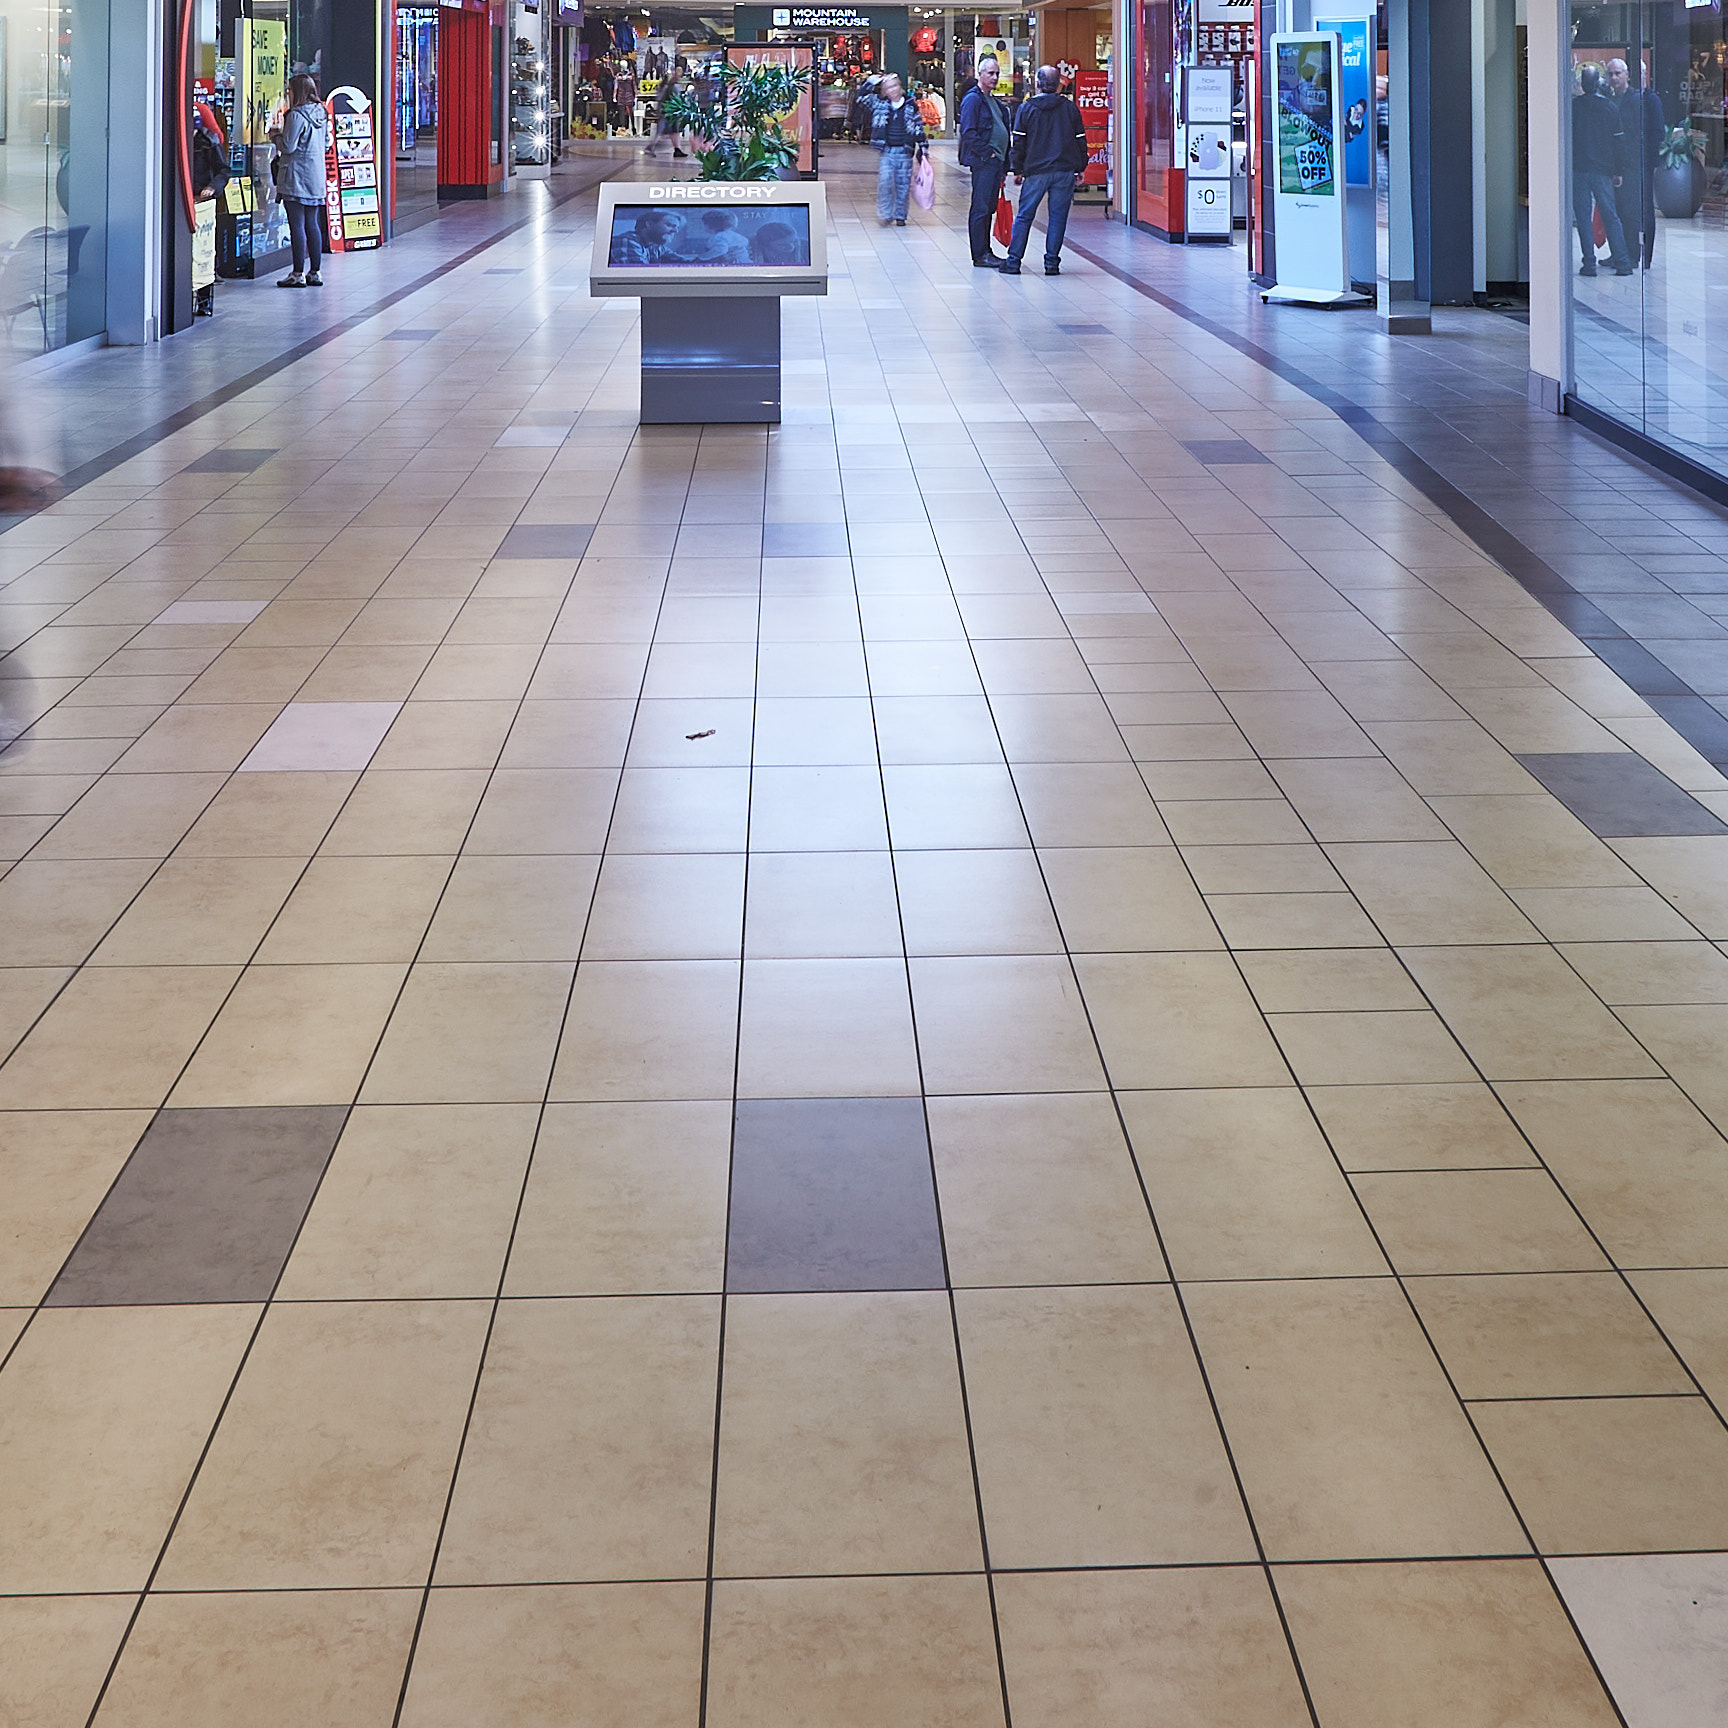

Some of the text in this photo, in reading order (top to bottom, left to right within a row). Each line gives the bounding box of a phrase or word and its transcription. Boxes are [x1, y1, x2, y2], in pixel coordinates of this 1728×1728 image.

[792, 8, 857, 17] MOUNTAIN
[792, 17, 870, 27] WAREHOUSE
[257, 56, 279, 76] MONEY
[1056, 59, 1078, 79] ty
[1299, 150, 1327, 165] 50%
[1301, 166, 1326, 181] OFF
[649, 186, 777, 199] DIRECTORY
[326, 179, 343, 241] CHECK
[357, 217, 376, 228] FREE
